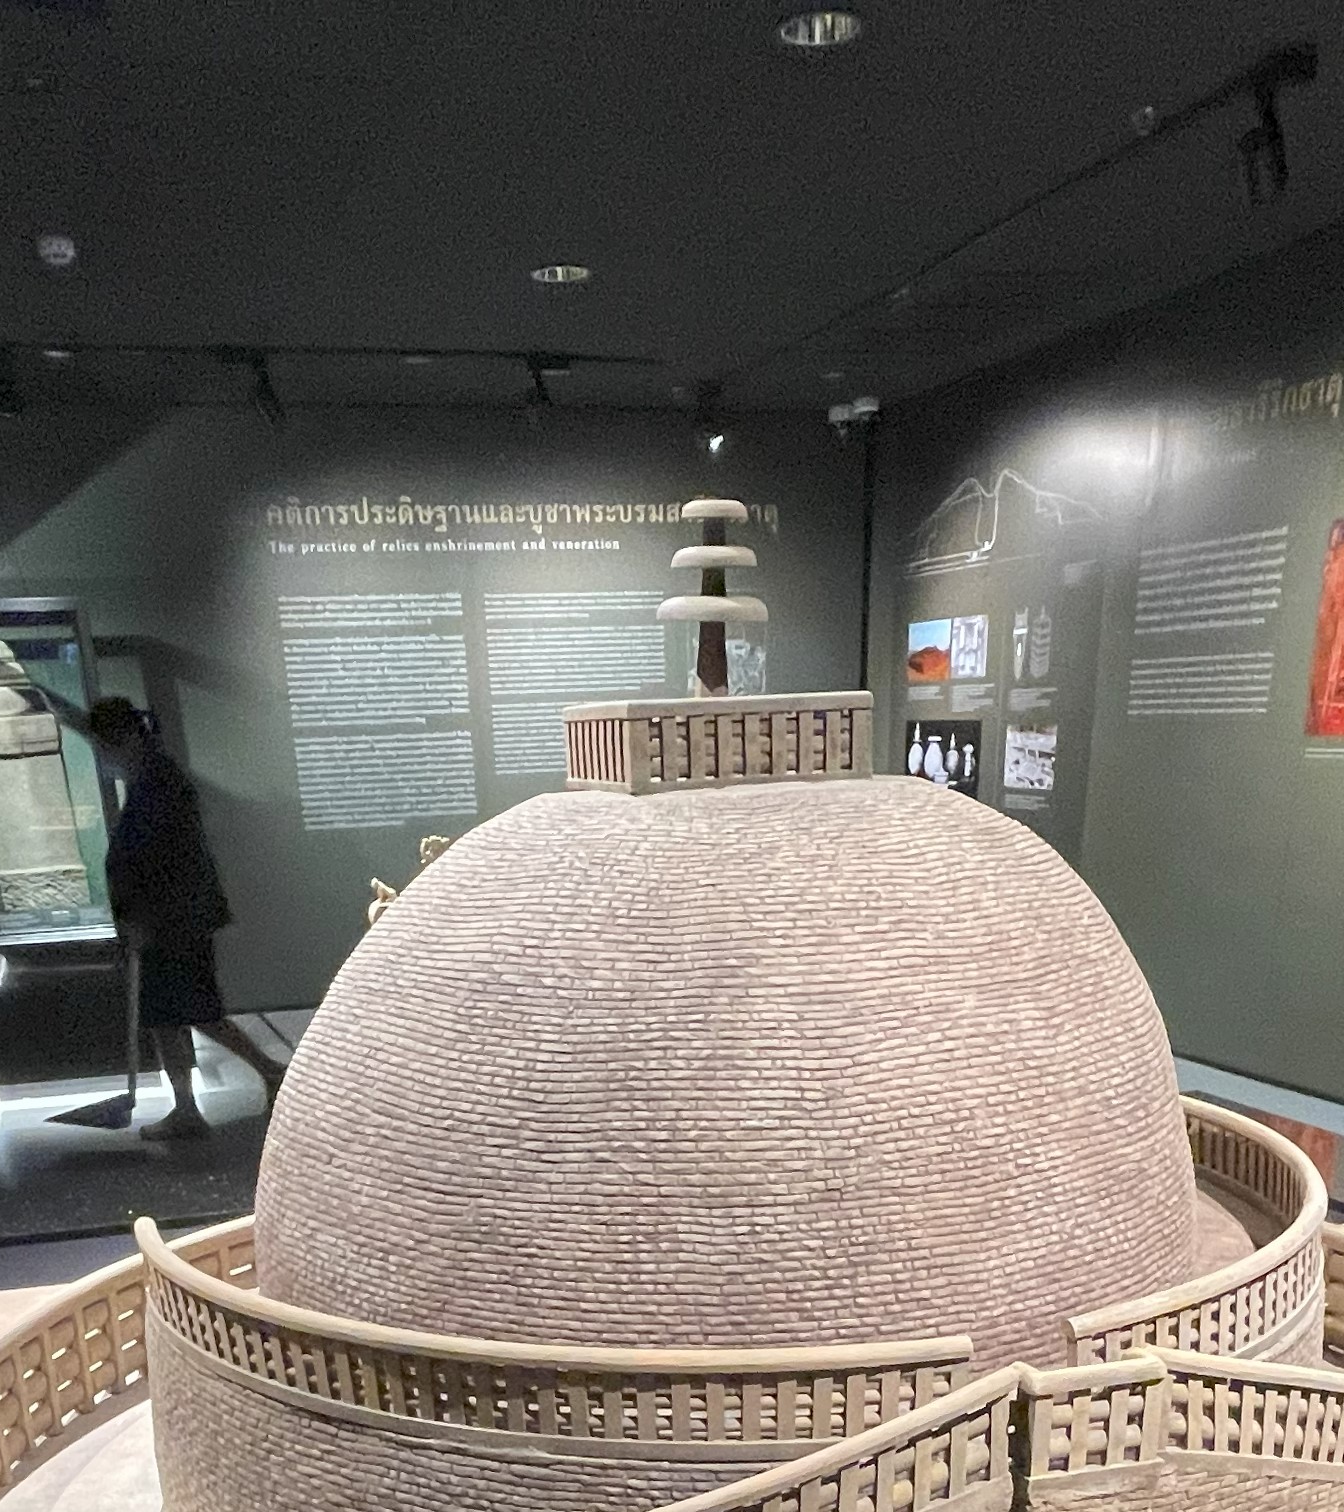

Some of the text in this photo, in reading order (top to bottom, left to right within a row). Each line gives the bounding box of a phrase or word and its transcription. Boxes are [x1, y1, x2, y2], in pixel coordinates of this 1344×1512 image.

[268, 538, 620, 555] The practice of relics enshrinement and veneration
